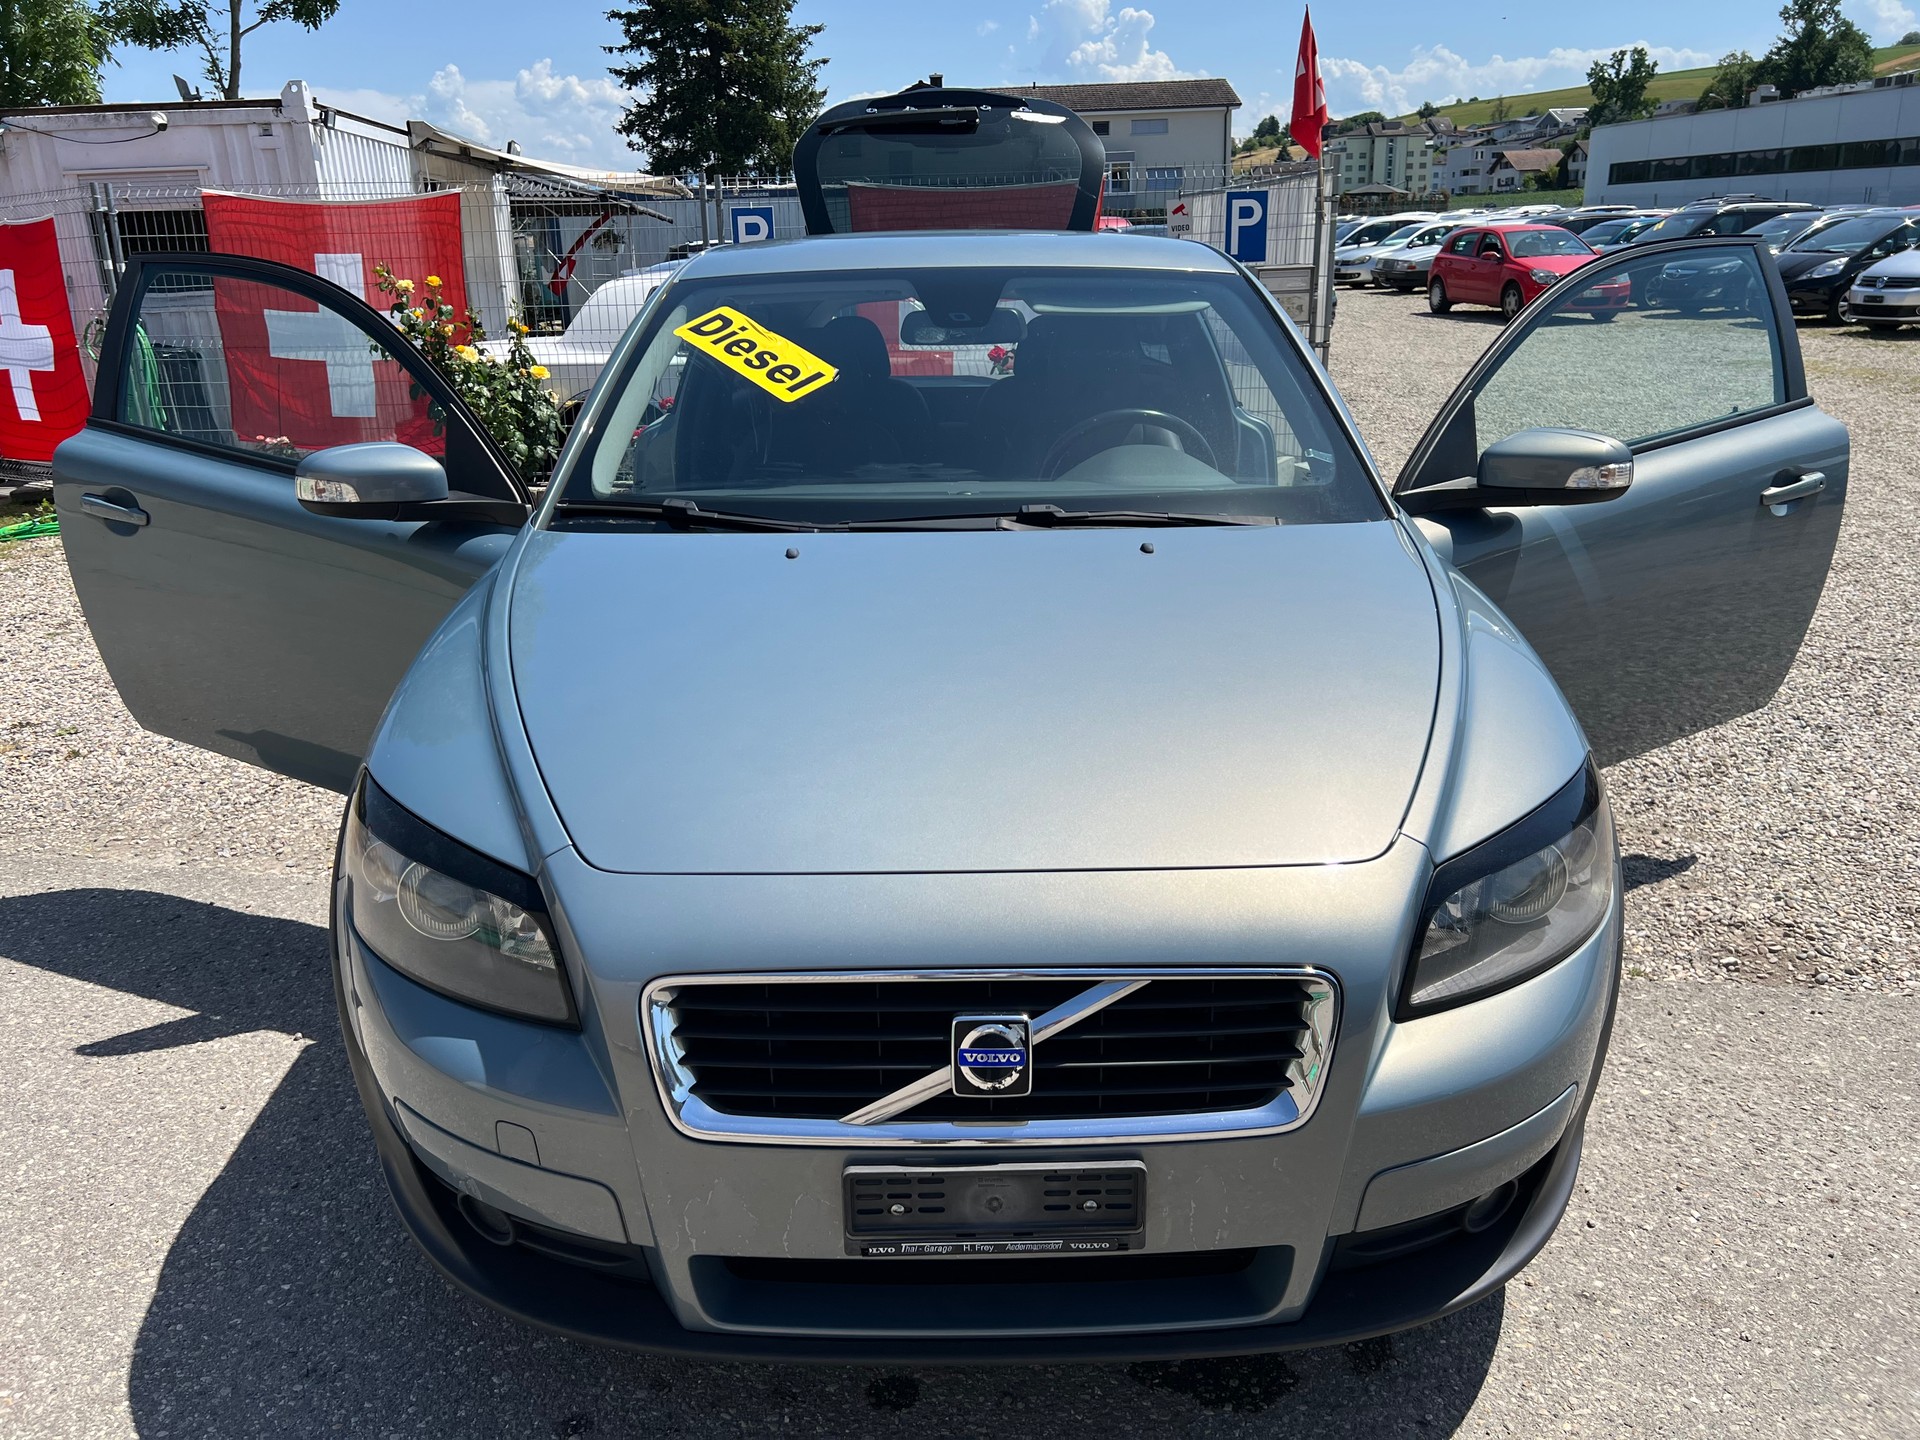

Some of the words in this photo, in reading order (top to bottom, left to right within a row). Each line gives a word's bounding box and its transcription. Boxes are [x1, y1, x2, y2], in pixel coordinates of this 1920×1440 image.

[1171, 224, 1190, 232] VIDEO
[1230, 199, 1263, 255] P
[687, 313, 826, 393] Diesel
[963, 1053, 1021, 1063] VOLVO
